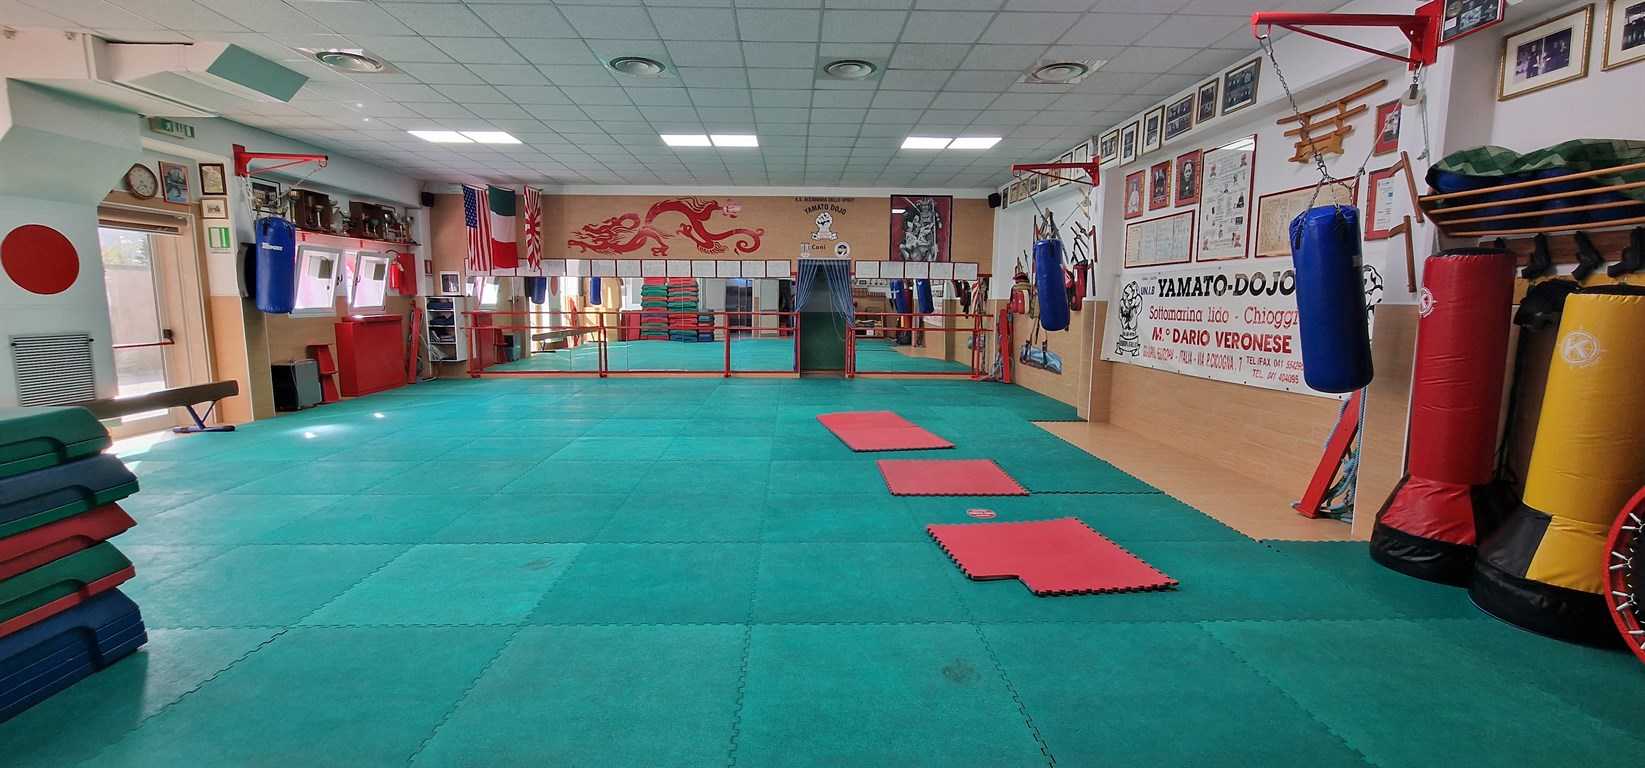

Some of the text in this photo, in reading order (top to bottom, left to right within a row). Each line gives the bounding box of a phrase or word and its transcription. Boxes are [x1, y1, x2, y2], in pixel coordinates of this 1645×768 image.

[804, 203, 847, 216] YAMATO DOJO
[1158, 270, 1296, 297] YAMATO-DOJO
[1149, 305, 1203, 322] Sottomarina
[1244, 306, 1298, 329] Chioggi
[1172, 328, 1211, 346] DARIO
[1215, 331, 1292, 353] VERONESE
